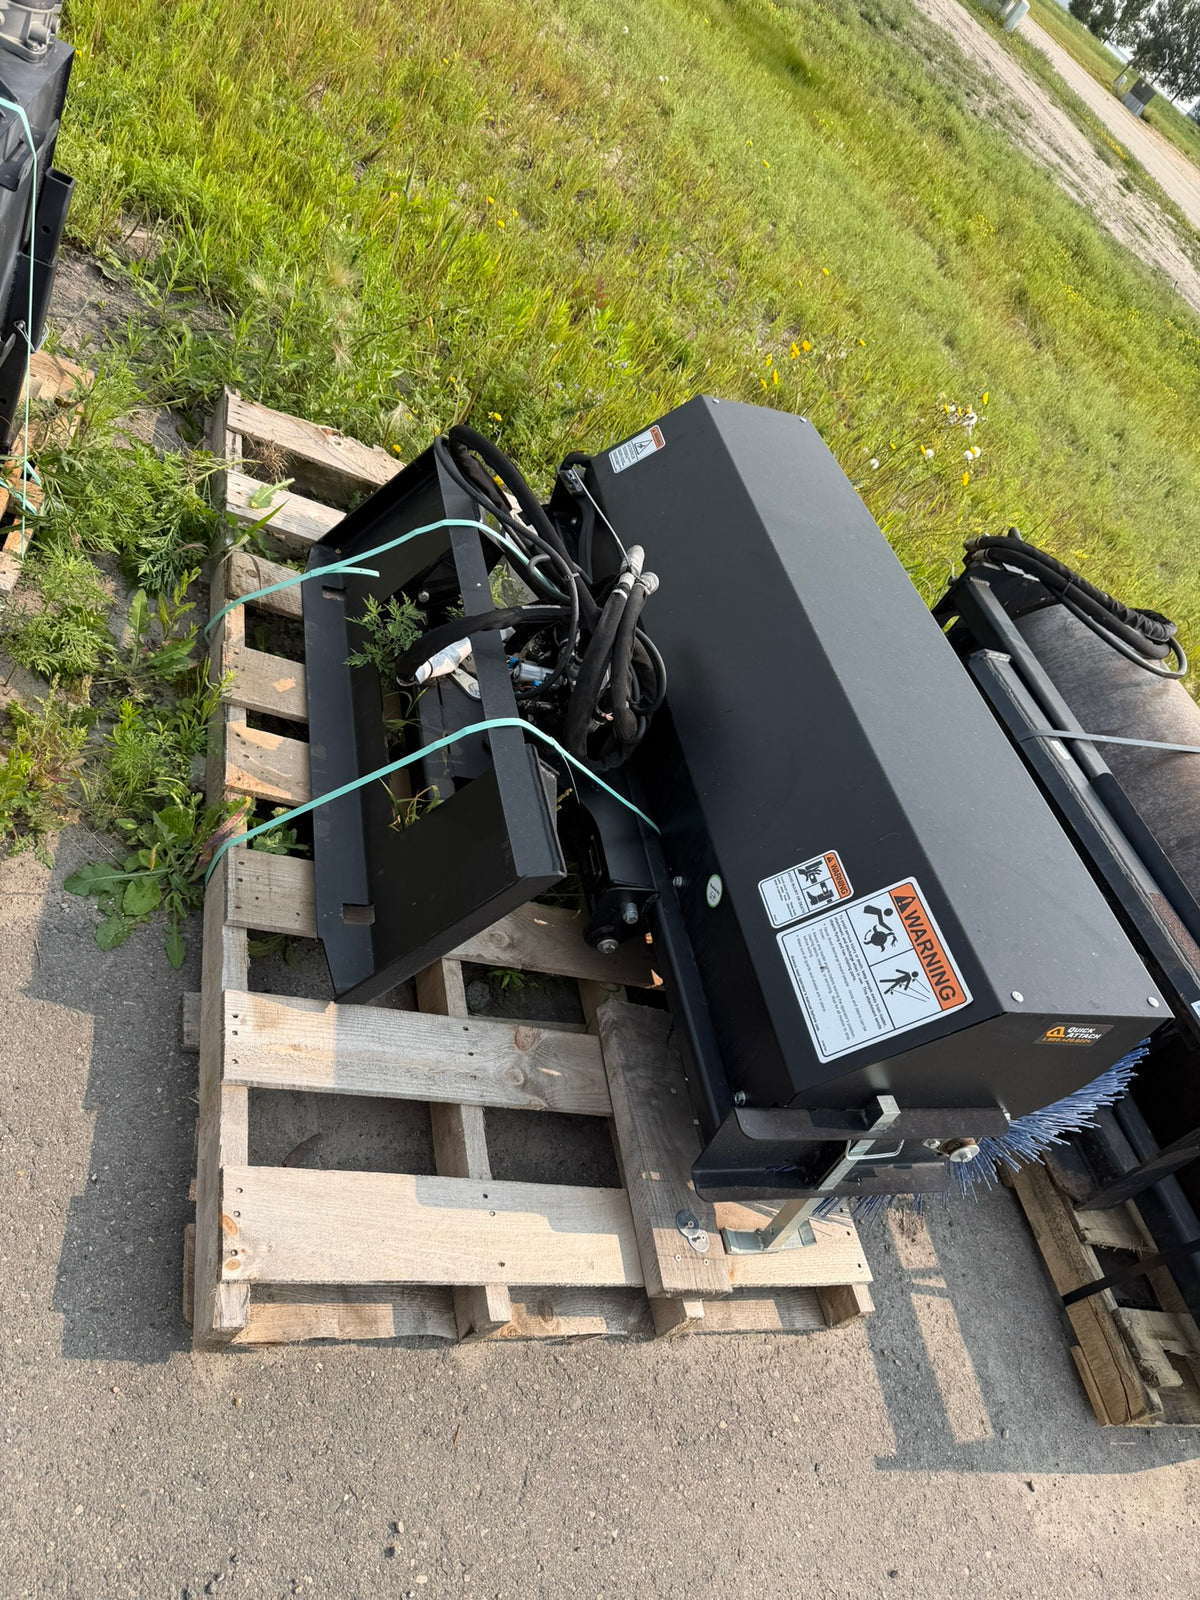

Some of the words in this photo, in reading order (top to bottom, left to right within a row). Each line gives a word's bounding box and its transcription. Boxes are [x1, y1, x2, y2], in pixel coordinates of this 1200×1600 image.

[830, 862, 848, 895] WARNING
[833, 931, 841, 942] flying
[843, 956, 852, 970] rotating
[844, 929, 852, 943] serious
[864, 979, 873, 993] people
[902, 909, 958, 1003] WARNING
[844, 944, 854, 962] discharge
[865, 995, 877, 1017] attachment
[874, 1017, 882, 1029] sends
